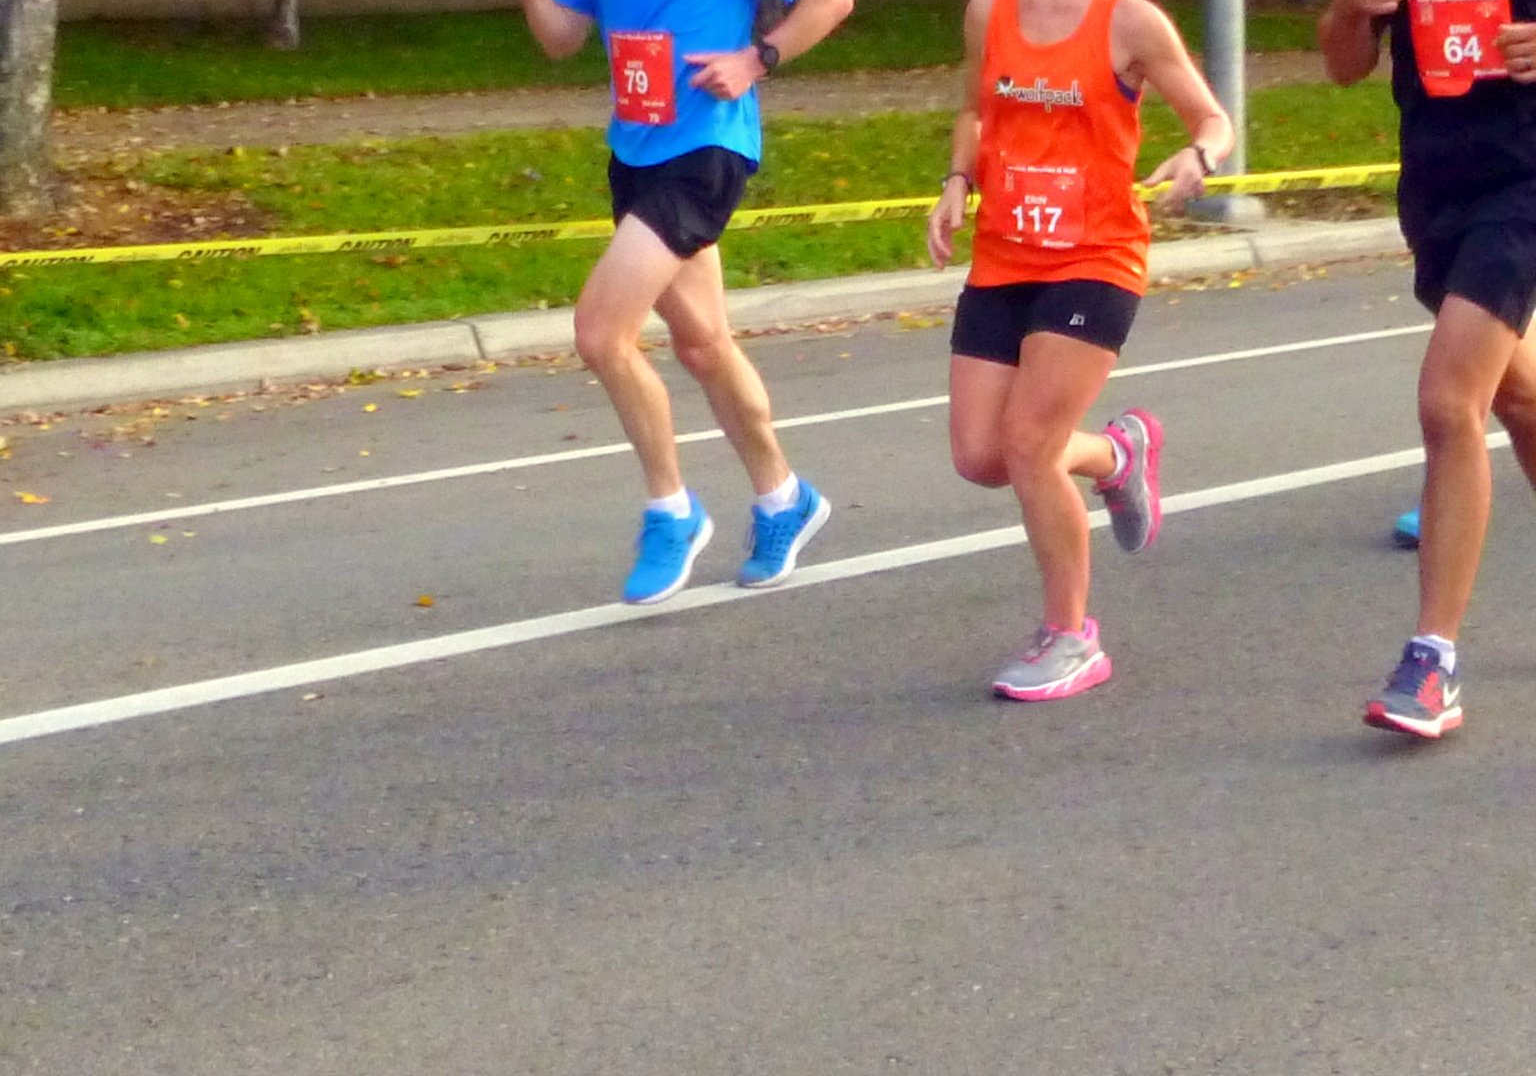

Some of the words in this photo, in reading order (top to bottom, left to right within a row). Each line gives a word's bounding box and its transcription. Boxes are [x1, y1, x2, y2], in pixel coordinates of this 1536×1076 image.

[1444, 35, 1481, 64] 64
[624, 69, 648, 94] 79
[1016, 77, 1083, 113] wolfpack
[1011, 205, 1062, 233] 117
[338, 237, 417, 252] CAUTION
